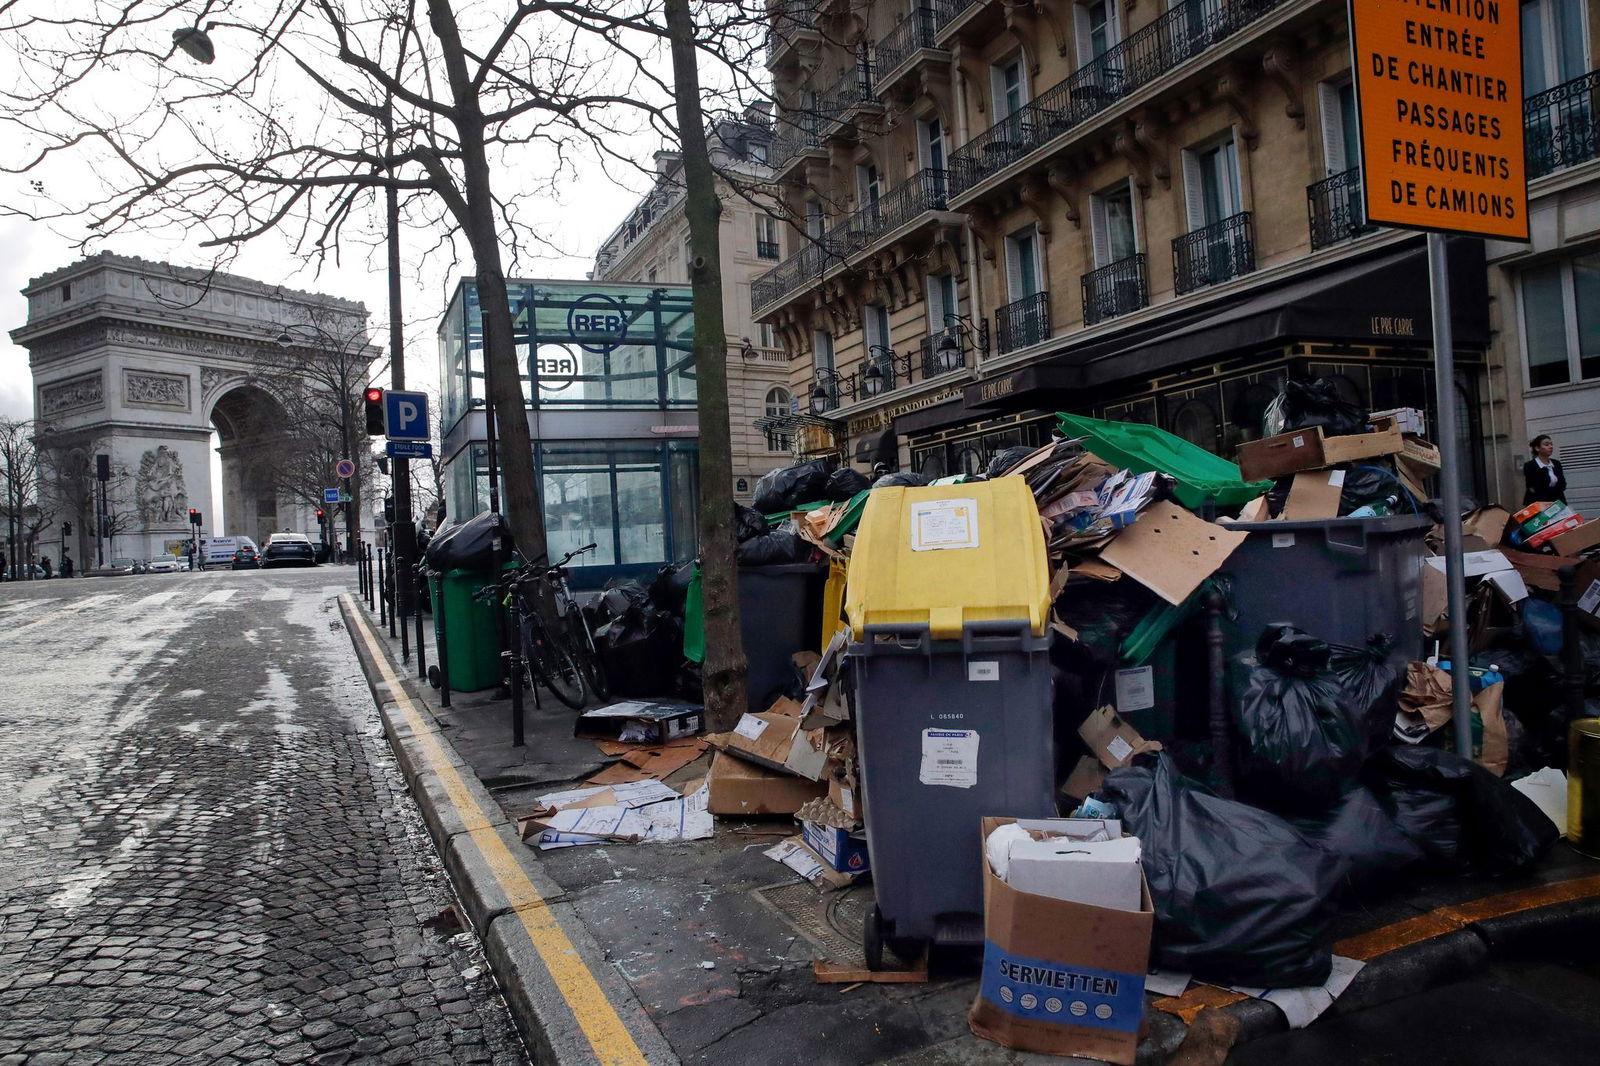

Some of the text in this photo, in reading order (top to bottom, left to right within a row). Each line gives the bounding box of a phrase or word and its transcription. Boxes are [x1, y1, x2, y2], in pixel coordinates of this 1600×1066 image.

[1403, 0, 1499, 24] NTION
[1405, 20, 1486, 59] ENTRÉE
[1372, 53, 1508, 102] DE CHANTIER
[1397, 98, 1501, 140] PASSAGES
[1392, 139, 1510, 180] FRÉQUENTS
[1391, 180, 1515, 219] DE CAMIONS
[575, 314, 622, 332] RER
[1371, 316, 1380, 335] LE
[398, 401, 418, 430] P
[999, 958, 1119, 996] SERVIETTEN
